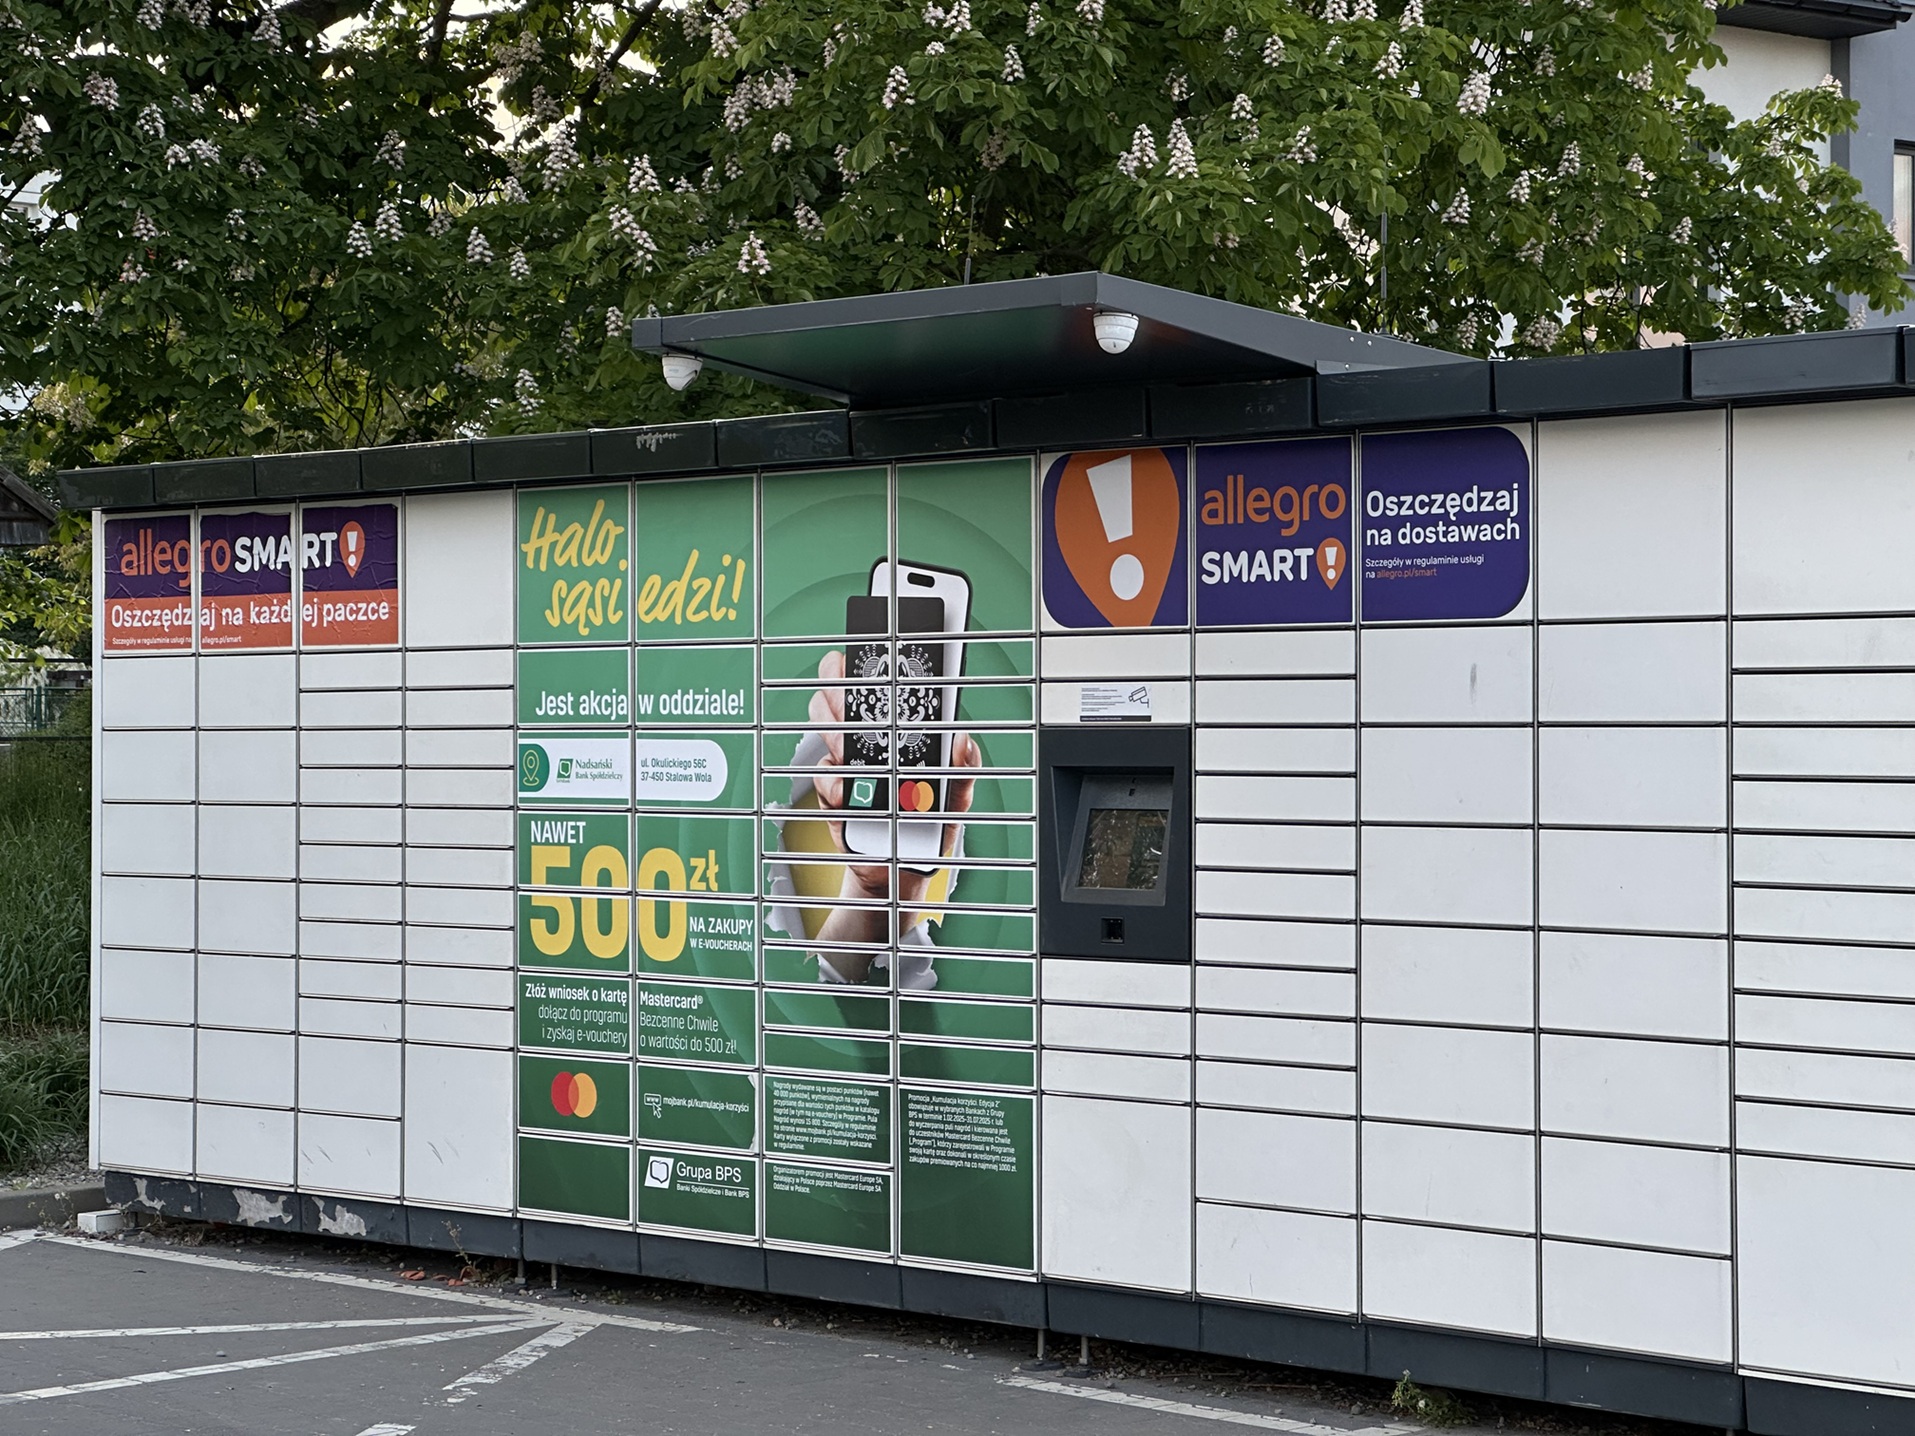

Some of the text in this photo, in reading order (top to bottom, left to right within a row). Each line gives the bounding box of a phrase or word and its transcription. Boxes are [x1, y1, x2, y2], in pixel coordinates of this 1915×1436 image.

[1201, 474, 1346, 537] allegro
[1366, 483, 1519, 519] Oszczędzaj
[1366, 519, 1520, 545] na dostawach
[120, 528, 231, 587] allegro
[1366, 557, 1404, 568] Szczegóły
[1413, 556, 1458, 568] regulaminie
[1460, 554, 1484, 566] usługi
[1376, 568, 1437, 579] allegro.pl/smart
[544, 548, 746, 636] sąsiedzi!
[111, 599, 389, 632] Oszczędzaj na każdej paczce
[142, 637, 170, 646] regulaminie
[202, 636, 242, 645] allegro.pl/smart
[535, 688, 745, 720] Jest akcja w oddziale!
[576, 758, 612, 769] Nadsański
[640, 759, 650, 768] ul.
[651, 758, 692, 770] Okulickiego
[576, 772, 623, 781] Bank Spółdzielczy
[640, 772, 712, 782] 37-450 Stalowa Wola
[530, 820, 586, 844] NAWET
[529, 844, 719, 962] 500 zł
[689, 916, 754, 936] NA ZAKUPY
[690, 938, 753, 952] W E-VOUCHERACH
[525, 983, 547, 999] Złóż
[548, 985, 590, 1002] wniosek
[592, 991, 599, 1001] o
[600, 987, 628, 1007] kartę
[538, 1005, 719, 1033] dołącz do programu Bezcenne Chwile
[542, 1025, 737, 1054] i zyskaj e-vouchery o wartości do 500 zł!
[662, 1096, 750, 1114] mojbank.pl/kumulacja-korzyści
[676, 1162, 742, 1183] Grupa BPS
[676, 1183, 690, 1192] Banki
[691, 1185, 721, 1196] Spółdzielcze
[724, 1188, 738, 1196] Bank
[738, 1190, 750, 1198] BPS
